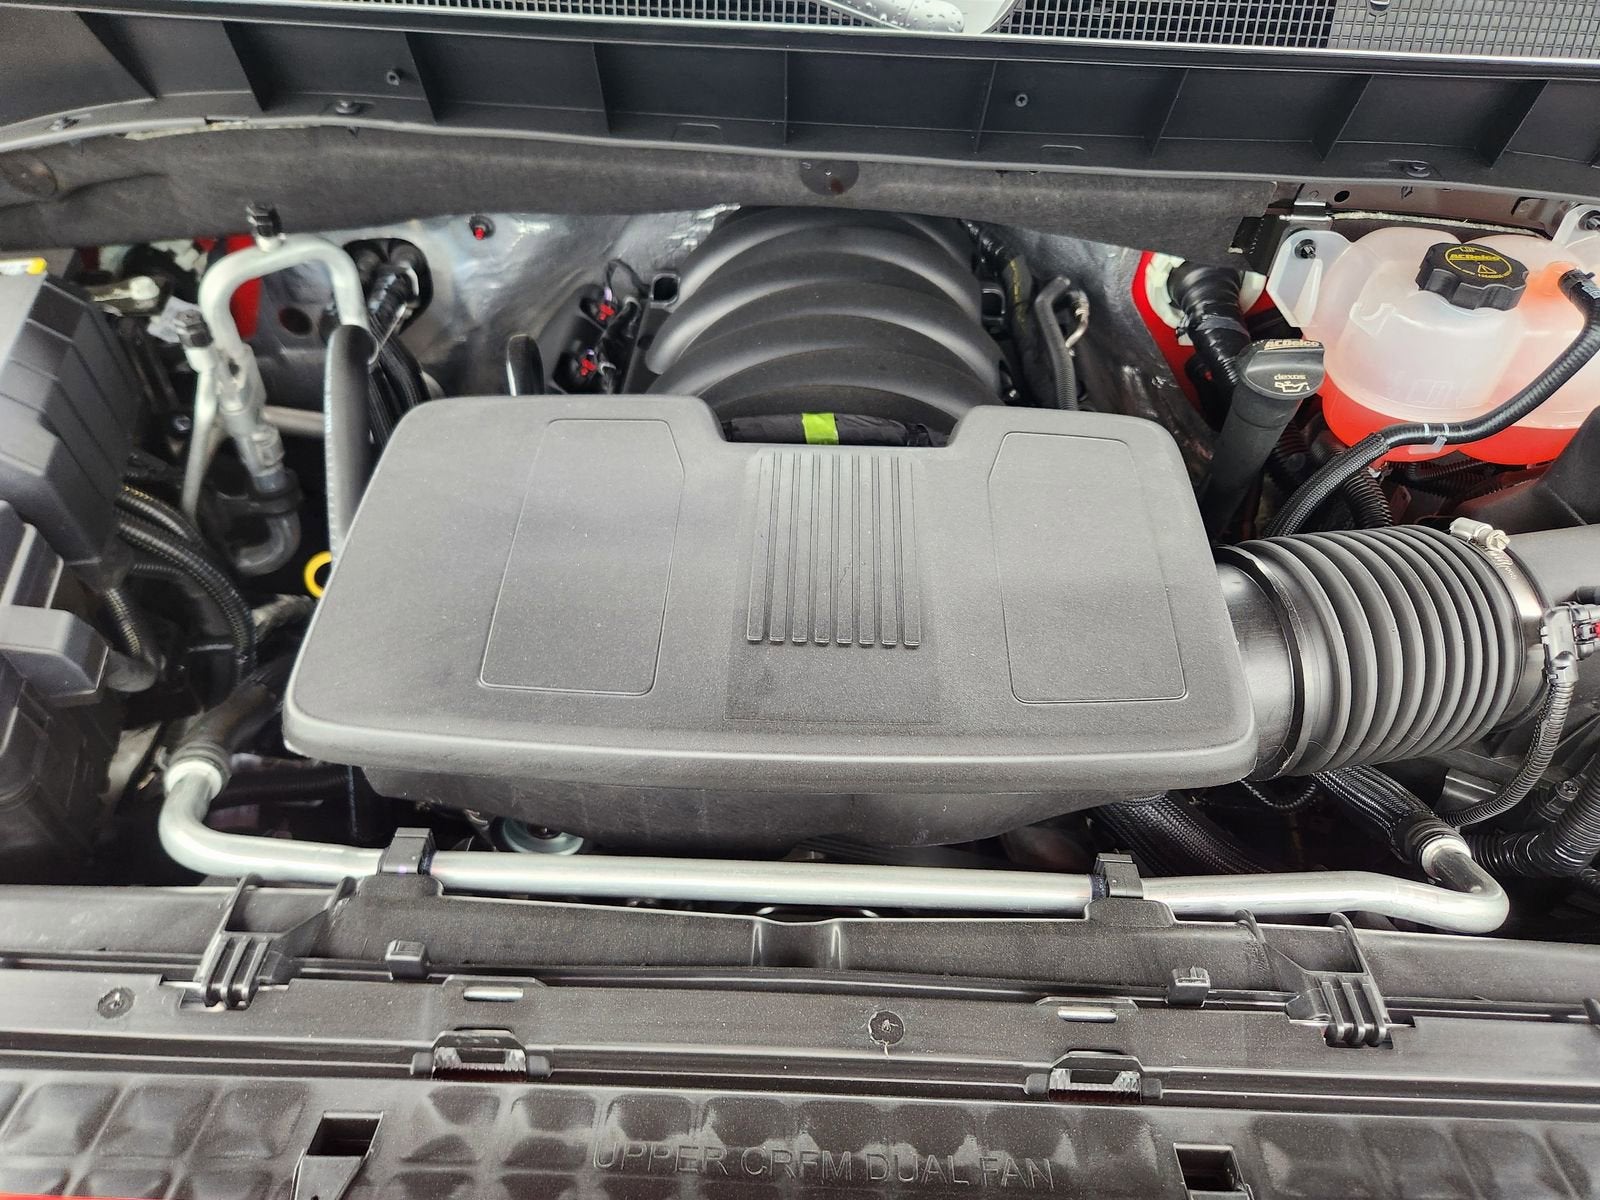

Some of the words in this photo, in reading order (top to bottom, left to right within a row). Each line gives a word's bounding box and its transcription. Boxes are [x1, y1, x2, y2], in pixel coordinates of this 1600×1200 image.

[1264, 339, 1320, 350] ACDelco
[593, 1141, 729, 1176] UPPER
[740, 1145, 851, 1182] CRFM
[865, 1152, 970, 1186] DUAL
[979, 1156, 1055, 1190] FAN
